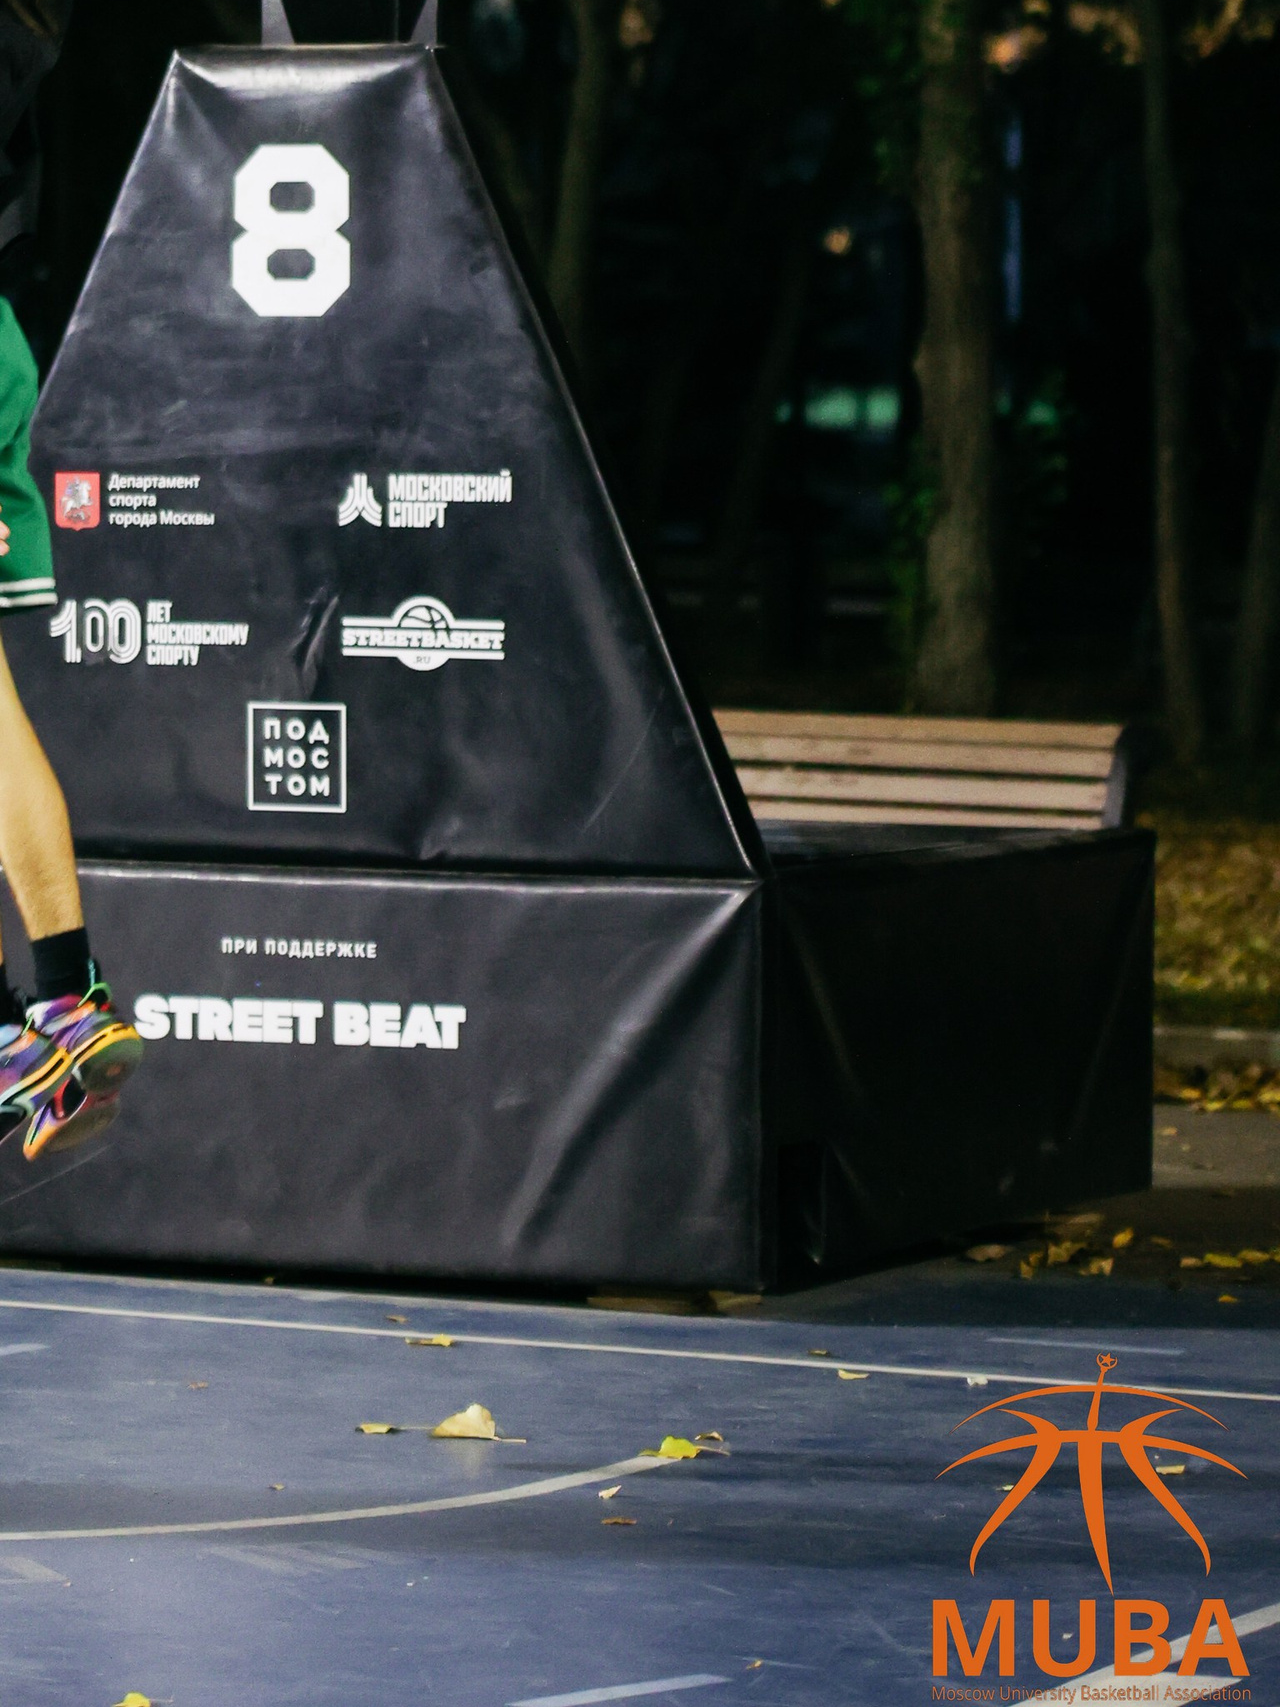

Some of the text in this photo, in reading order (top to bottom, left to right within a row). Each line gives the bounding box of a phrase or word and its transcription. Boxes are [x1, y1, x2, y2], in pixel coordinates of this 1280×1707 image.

[231, 143, 351, 318] 8
[108, 473, 201, 492] Департамент
[387, 469, 512, 503] МОСКОВСКИЙ
[108, 493, 157, 509] спорта
[108, 511, 215, 527] города Москвы
[387, 502, 447, 528] СПОРТ
[146, 600, 173, 623] ЛЕТ
[49, 598, 142, 664] 100
[146, 623, 249, 645] МОСКОВСКОМУ
[341, 627, 505, 650] STREETBASKET
[146, 645, 200, 666] СПОРТУ
[264, 717, 330, 744] ПОД
[264, 747, 329, 769] МОС
[265, 774, 330, 797] ТОМ
[221, 937, 378, 959] ПРИ ПОДДЕРЖКЕ
[133, 994, 467, 1049] STREET BEAT
